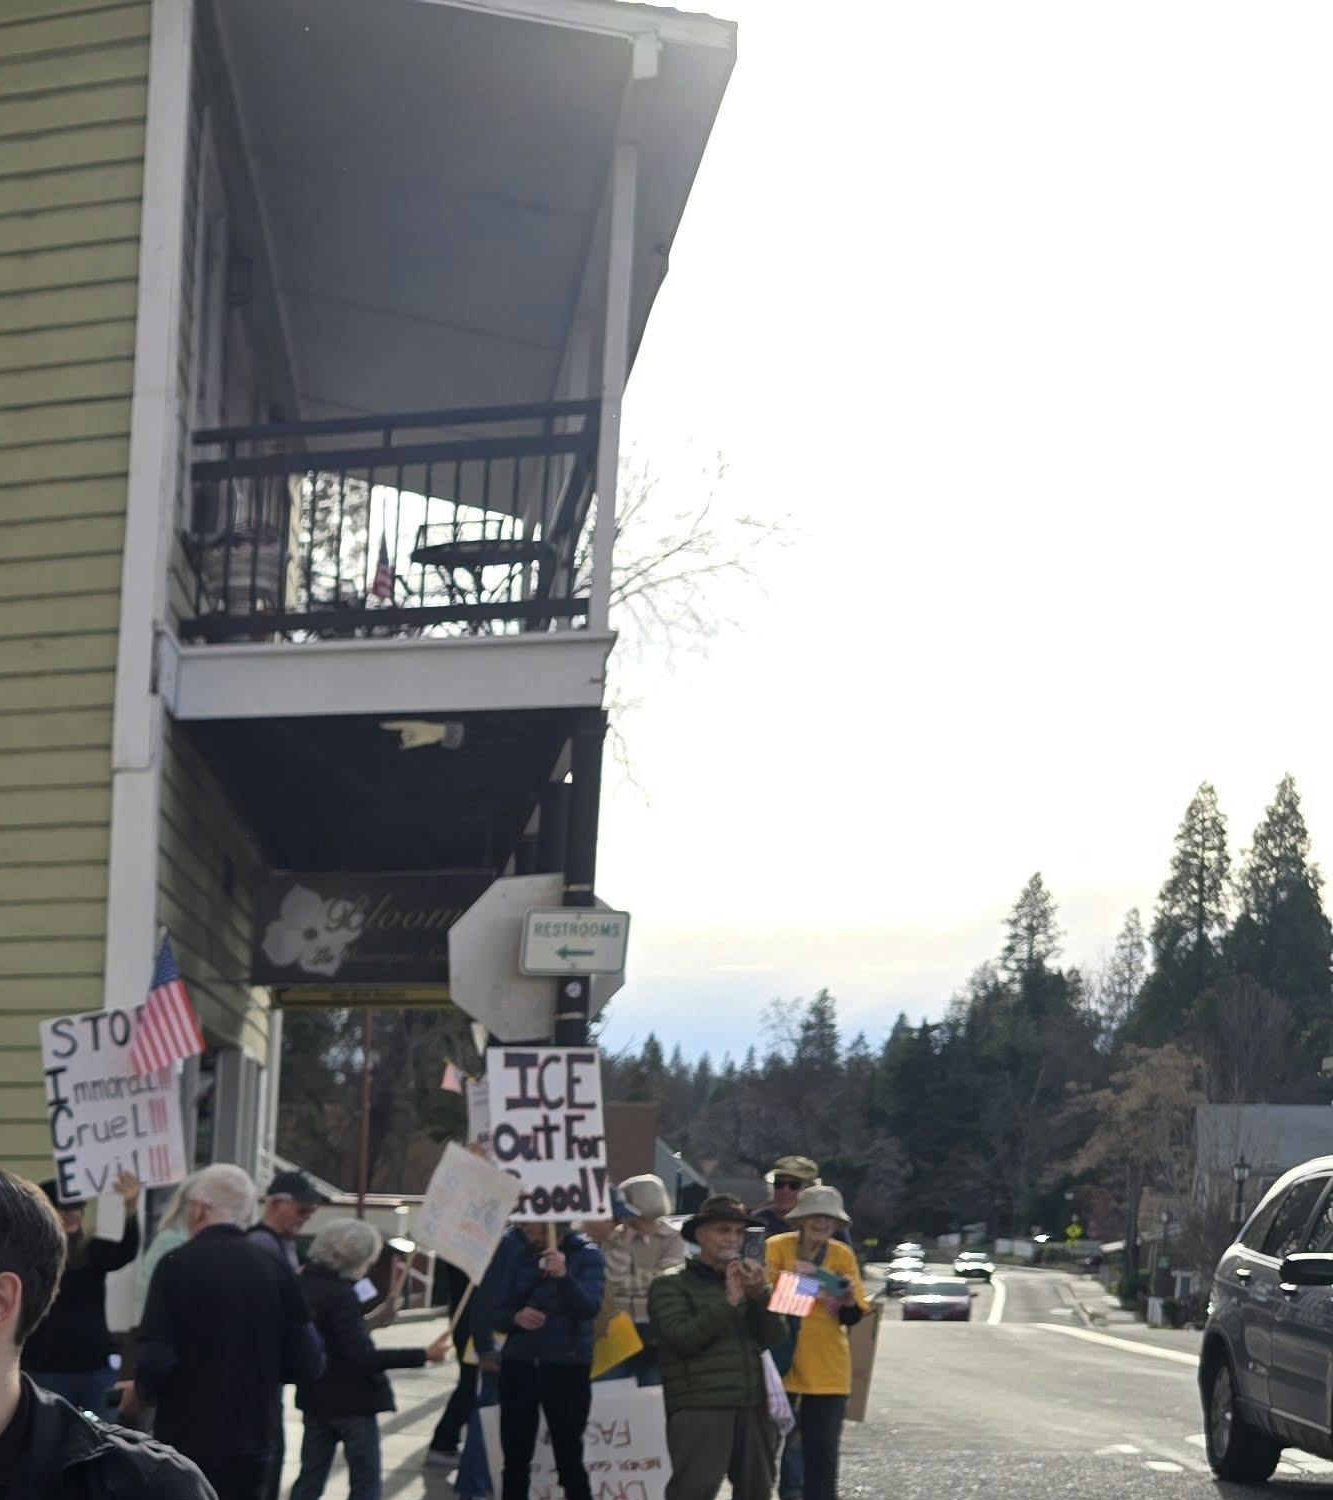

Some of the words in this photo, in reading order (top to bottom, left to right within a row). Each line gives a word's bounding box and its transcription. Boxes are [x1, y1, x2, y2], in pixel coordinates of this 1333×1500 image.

[533, 920, 621, 938] RESTROOMS
[503, 1052, 596, 1112] ICE
[492, 1113, 561, 1163] Out
[564, 1114, 605, 1160] For
